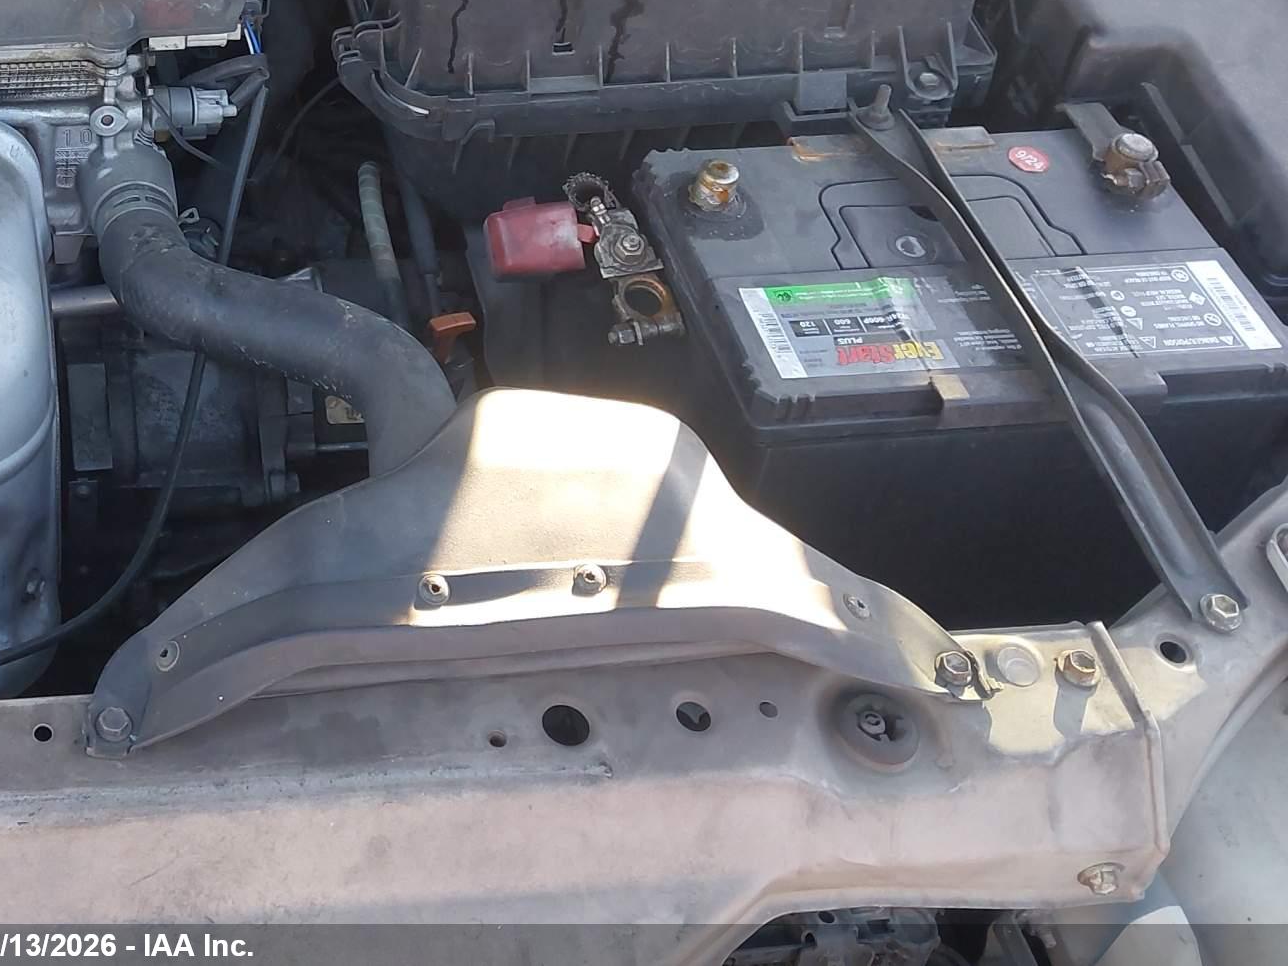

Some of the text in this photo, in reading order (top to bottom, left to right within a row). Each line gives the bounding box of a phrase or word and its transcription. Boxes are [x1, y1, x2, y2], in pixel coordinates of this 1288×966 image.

[1015, 150, 1046, 170] 9/24
[837, 337, 863, 346] PLUS
[837, 341, 945, 366] EverStart
